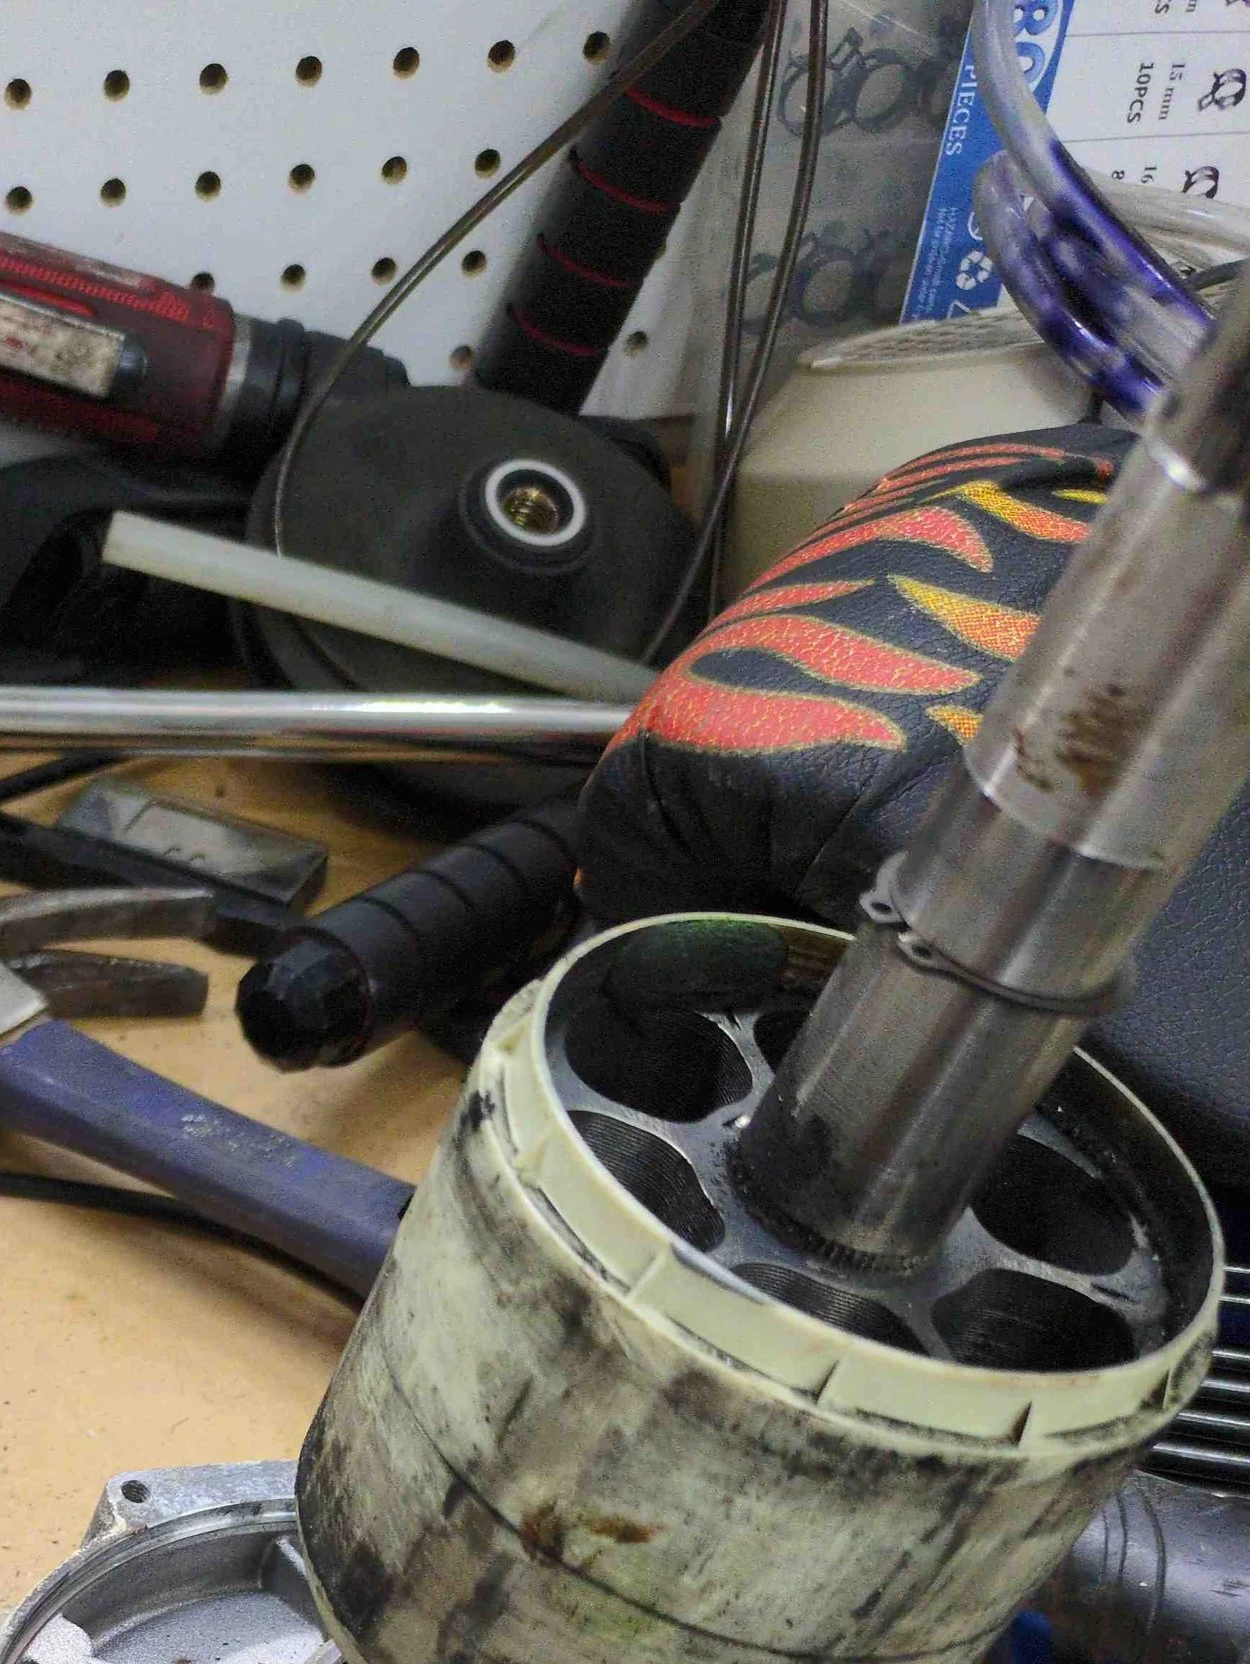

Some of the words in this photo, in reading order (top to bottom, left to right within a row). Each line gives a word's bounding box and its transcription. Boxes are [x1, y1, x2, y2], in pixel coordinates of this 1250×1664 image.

[1169, 63, 1185, 81] 15
[1126, 62, 1155, 123] 10PCS
[1158, 87, 1174, 120] mm
